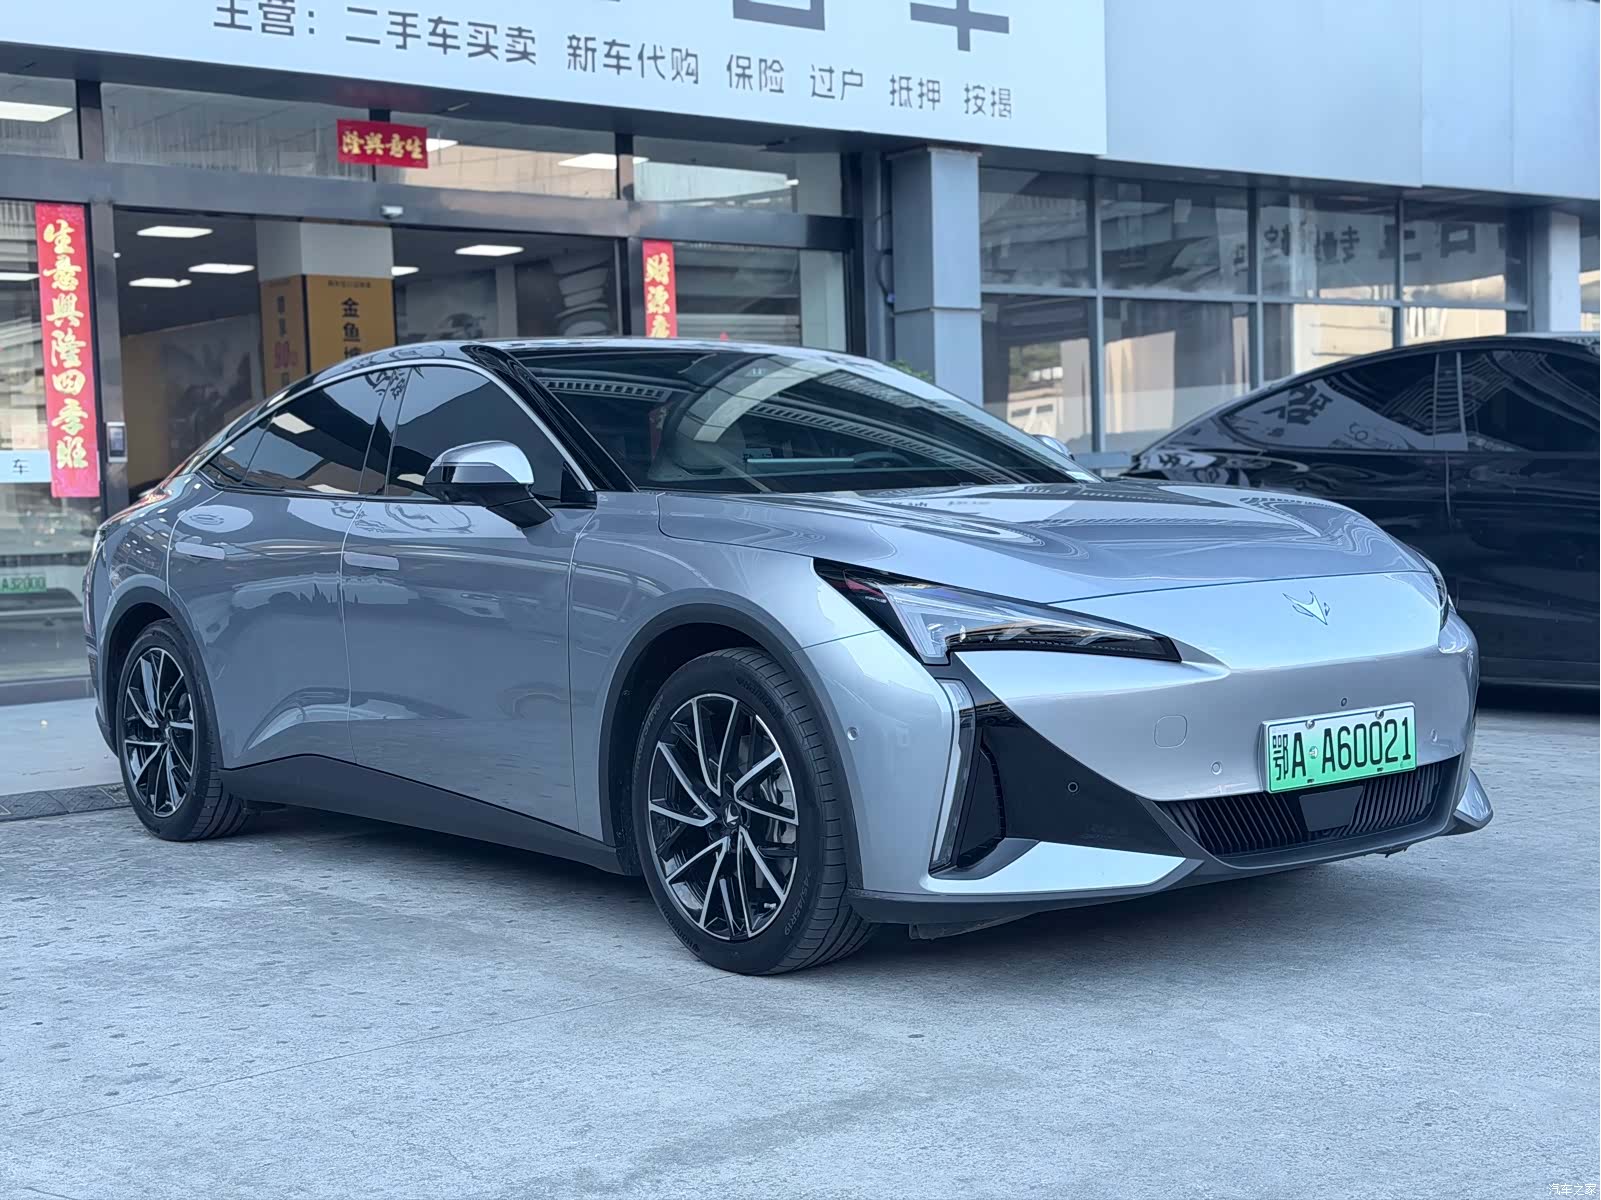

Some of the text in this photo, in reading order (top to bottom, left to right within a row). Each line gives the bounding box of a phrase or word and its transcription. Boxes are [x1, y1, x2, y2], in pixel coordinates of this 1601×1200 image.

[567, 34, 700, 85] 新车代购
[726, 54, 785, 94] 保险
[810, 64, 864, 101] 过户
[889, 74, 941, 111] 抵押
[963, 83, 1012, 119] 按揭
[1321, 716, 1412, 774] A60021
